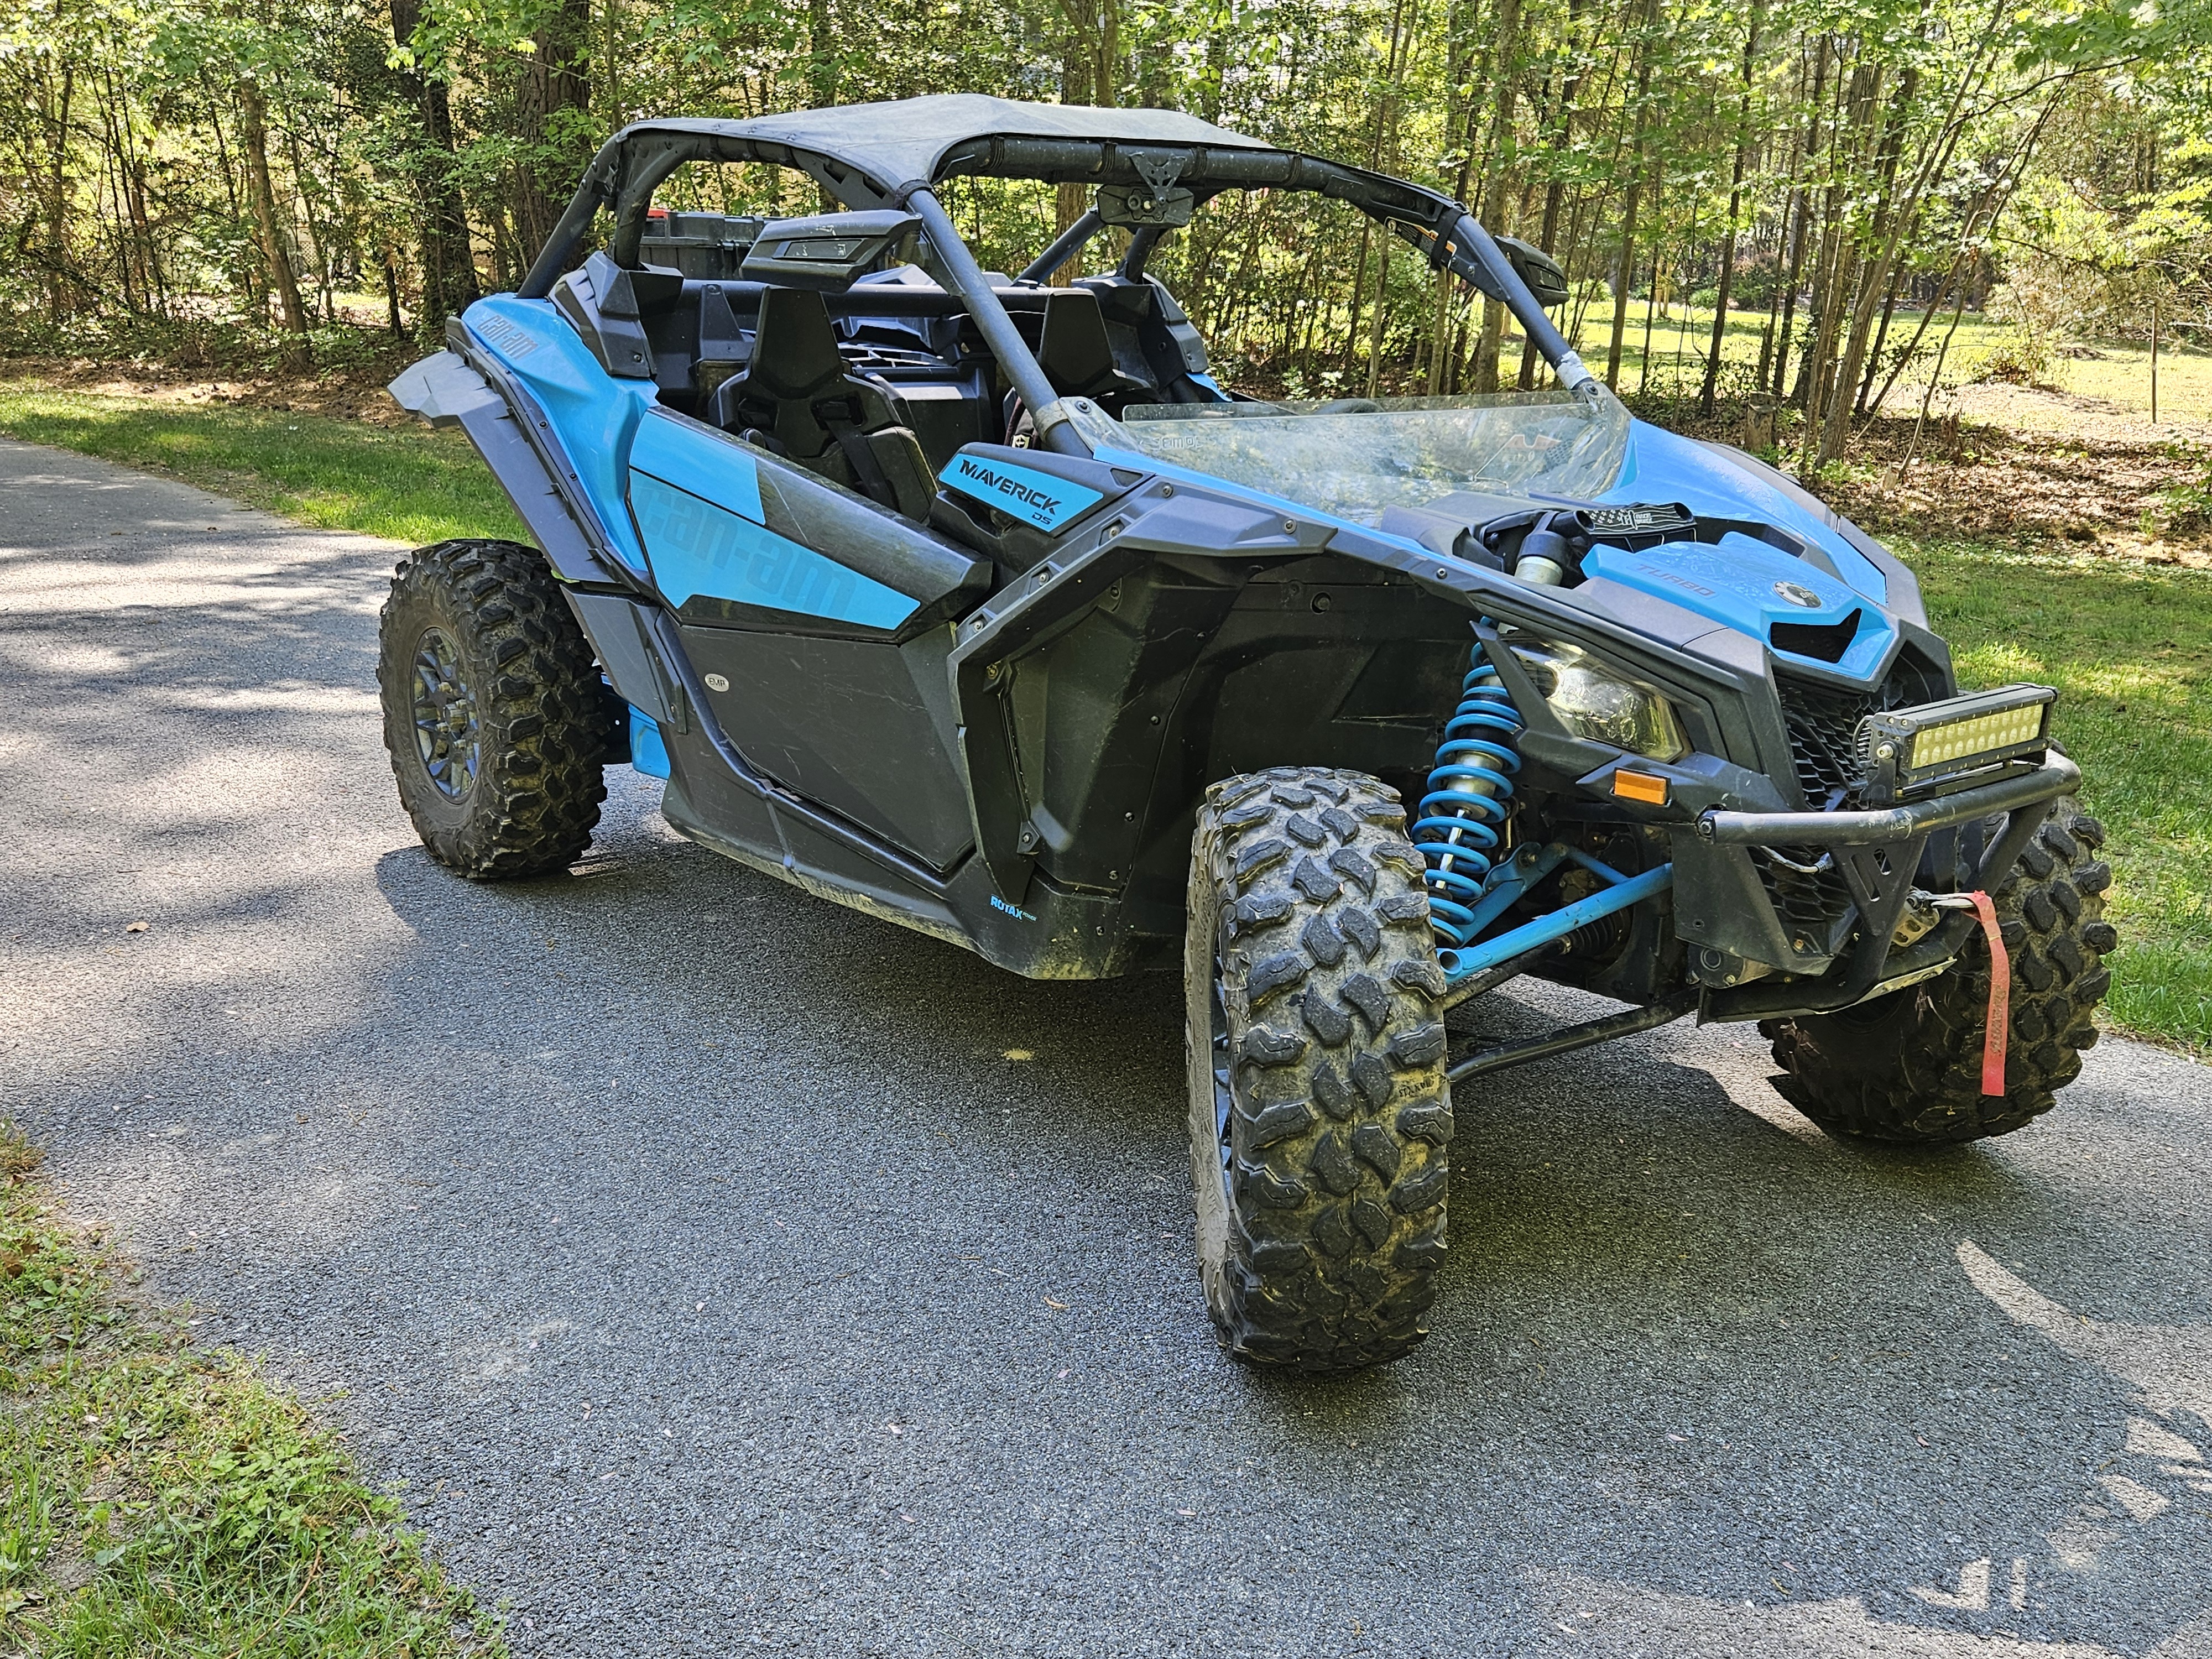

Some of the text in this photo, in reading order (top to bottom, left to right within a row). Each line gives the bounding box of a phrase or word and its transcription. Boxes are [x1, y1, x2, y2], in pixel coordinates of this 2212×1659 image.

[477, 315, 539, 360] can-am
[959, 459, 1062, 515] MAVERICK
[1031, 512, 1053, 525] DS
[633, 480, 857, 618] can-am
[1636, 564, 1716, 596] TURBO
[709, 677, 725, 687] EMP
[990, 895, 1037, 921] ROTAX POWER
